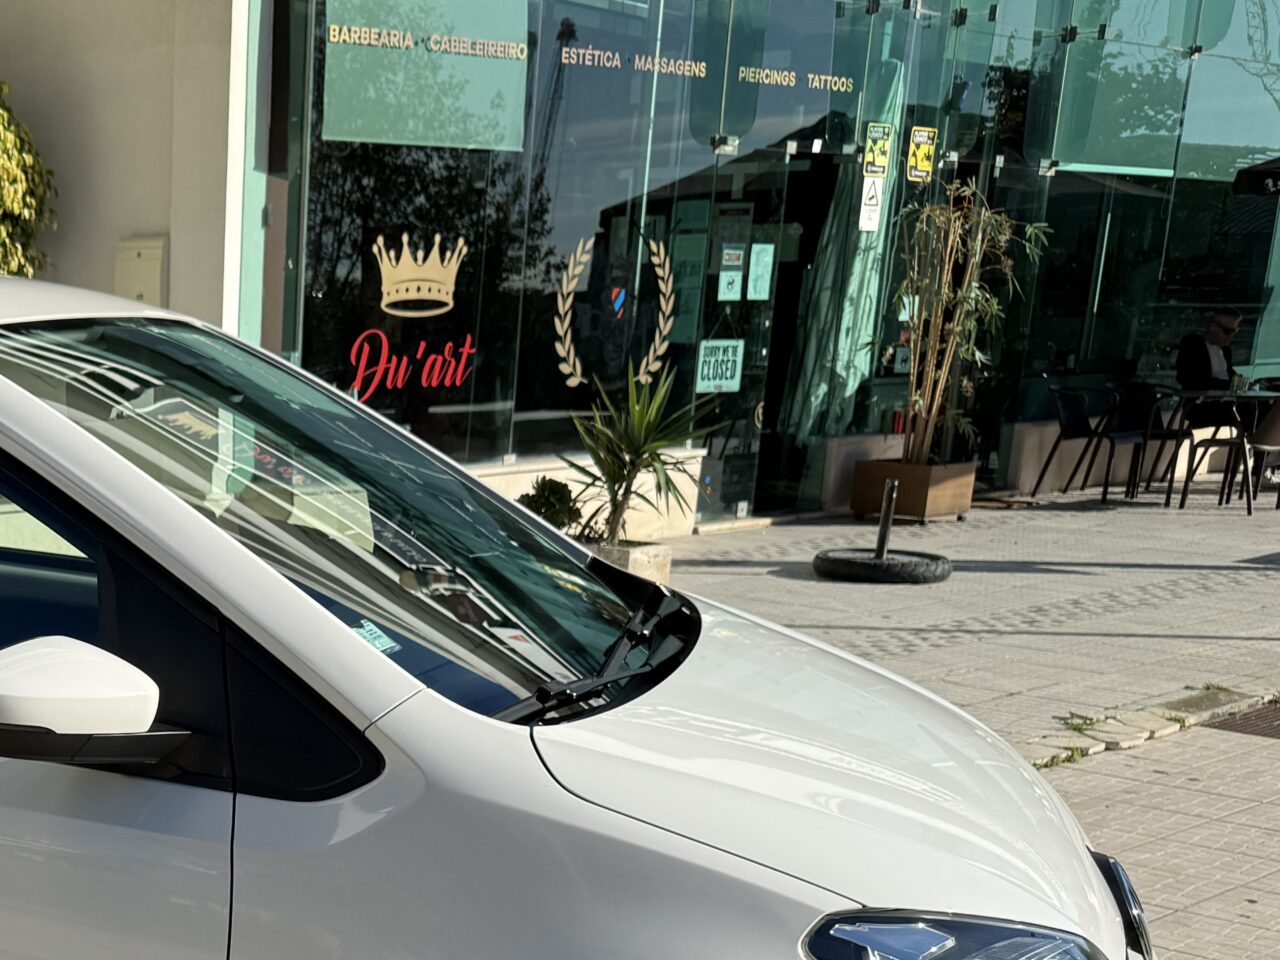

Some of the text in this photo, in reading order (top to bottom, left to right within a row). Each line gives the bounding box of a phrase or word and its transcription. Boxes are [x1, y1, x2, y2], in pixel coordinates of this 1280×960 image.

[329, 24, 528, 60] BARBEARIA CABELEIREIRO
[561, 45, 707, 78] ESTÉTICA MASSAGENS
[738, 66, 854, 93] PIERCINGS TATTOOS
[348, 329, 477, 403] Du'art
[700, 359, 737, 381] CLOSED
